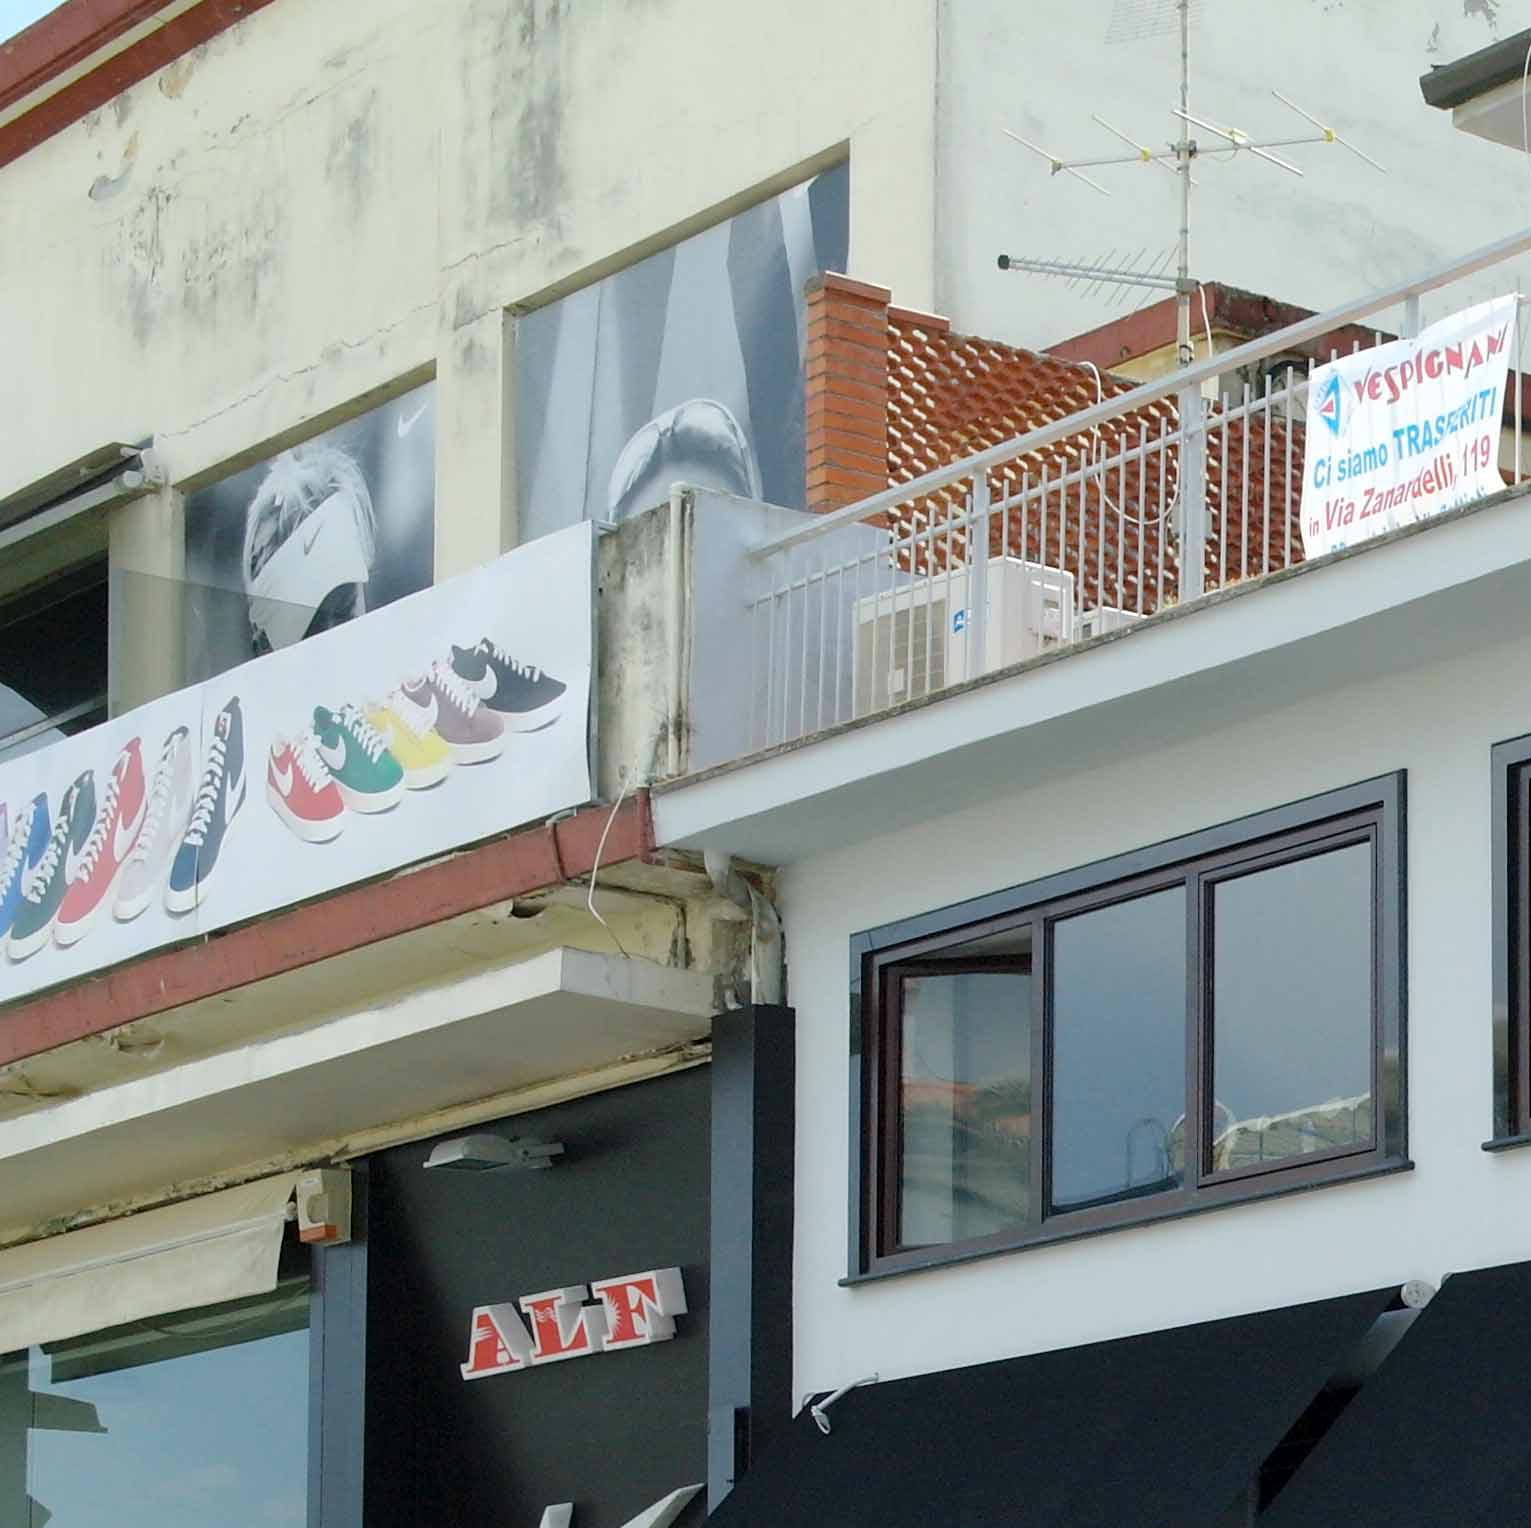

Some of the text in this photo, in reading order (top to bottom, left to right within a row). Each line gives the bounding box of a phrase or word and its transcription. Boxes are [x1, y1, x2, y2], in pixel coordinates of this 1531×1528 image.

[1354, 321, 1508, 405] VESPIGNANI
[1309, 517, 1320, 537] in
[1325, 498, 1356, 531] Via
[1359, 453, 1457, 520] Zanardelli,
[1463, 434, 1491, 477] 119
[1313, 456, 1332, 489] Ci
[1337, 443, 1388, 482] siamo
[459, 1266, 688, 1381] ALF
